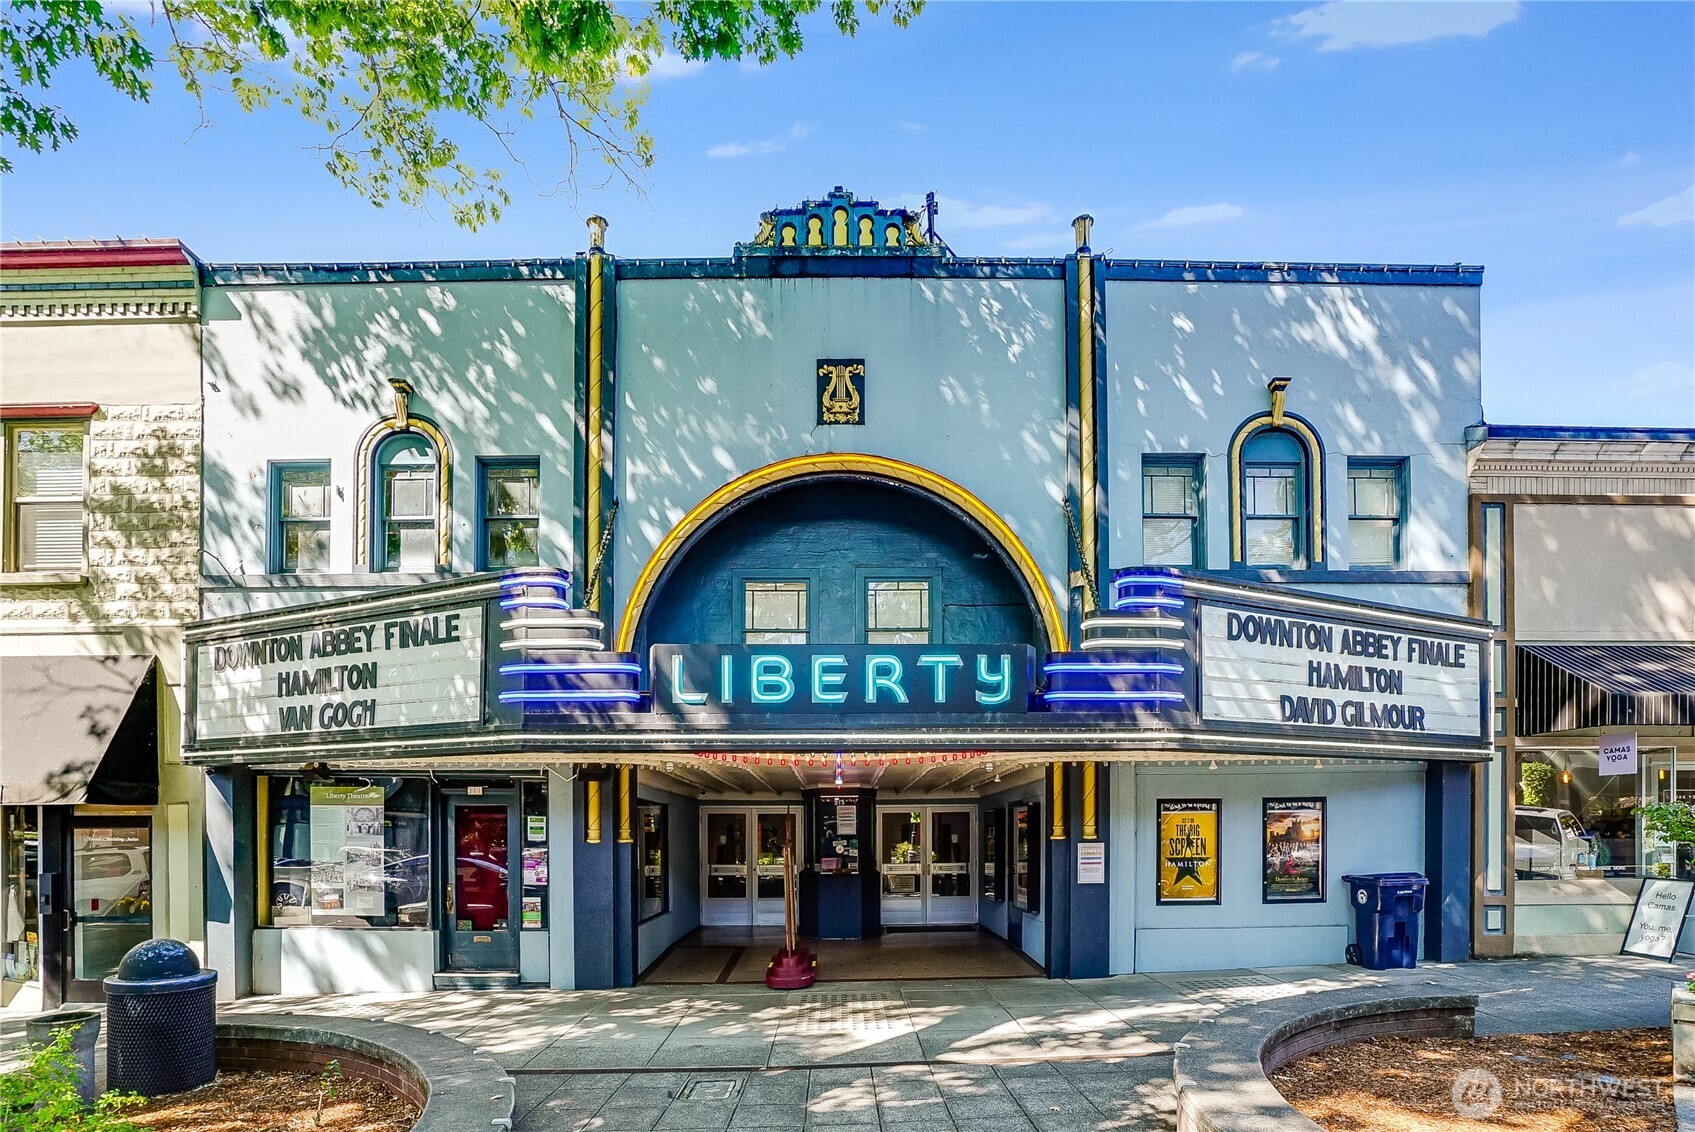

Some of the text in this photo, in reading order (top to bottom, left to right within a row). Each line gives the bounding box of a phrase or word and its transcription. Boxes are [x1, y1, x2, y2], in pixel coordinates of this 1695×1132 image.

[214, 613, 460, 672] DOWNTON ABBEY FINALE
[1227, 612, 1466, 668] DOWNTON ABBEY FINALE
[277, 661, 378, 698] HAMILTON
[671, 652, 1011, 706] LIBERTY
[1308, 660, 1403, 695] HAMILTON
[278, 699, 376, 733] VAN GOGH
[1280, 695, 1425, 731] DAVID GILMOUR
[1603, 746, 1631, 755] CAMAS
[1606, 754, 1628, 762] YOGA
[326, 792, 369, 800] Liberty Theatre
[1175, 824, 1187, 837] THE
[1164, 860, 1211, 868] HAMILTON
[1655, 891, 1677, 901] Hello
[1647, 901, 1678, 912] Camas.
[1640, 922, 1656, 932] You,
[1640, 934, 1666, 944] yoga?
